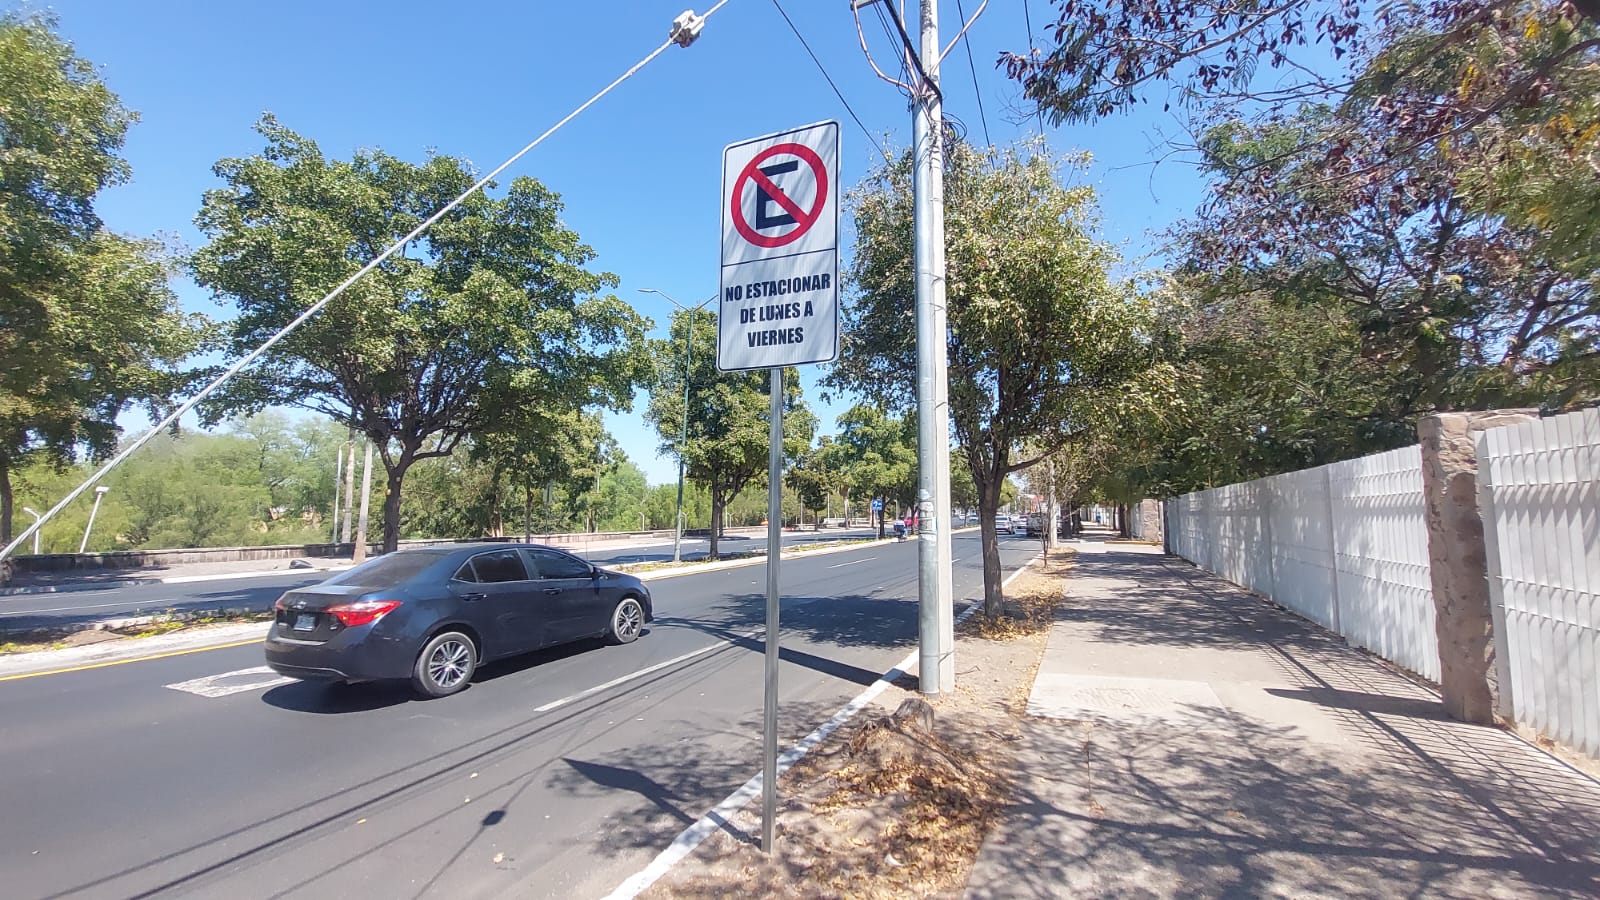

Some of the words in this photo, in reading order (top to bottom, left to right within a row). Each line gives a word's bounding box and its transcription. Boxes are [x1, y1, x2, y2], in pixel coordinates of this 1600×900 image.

[725, 286, 743, 302] NO
[745, 273, 831, 299] ESTACIONAR
[740, 308, 756, 324] DE
[759, 302, 801, 321] LUNES
[804, 300, 813, 317] A
[747, 327, 804, 348] VIERNES
